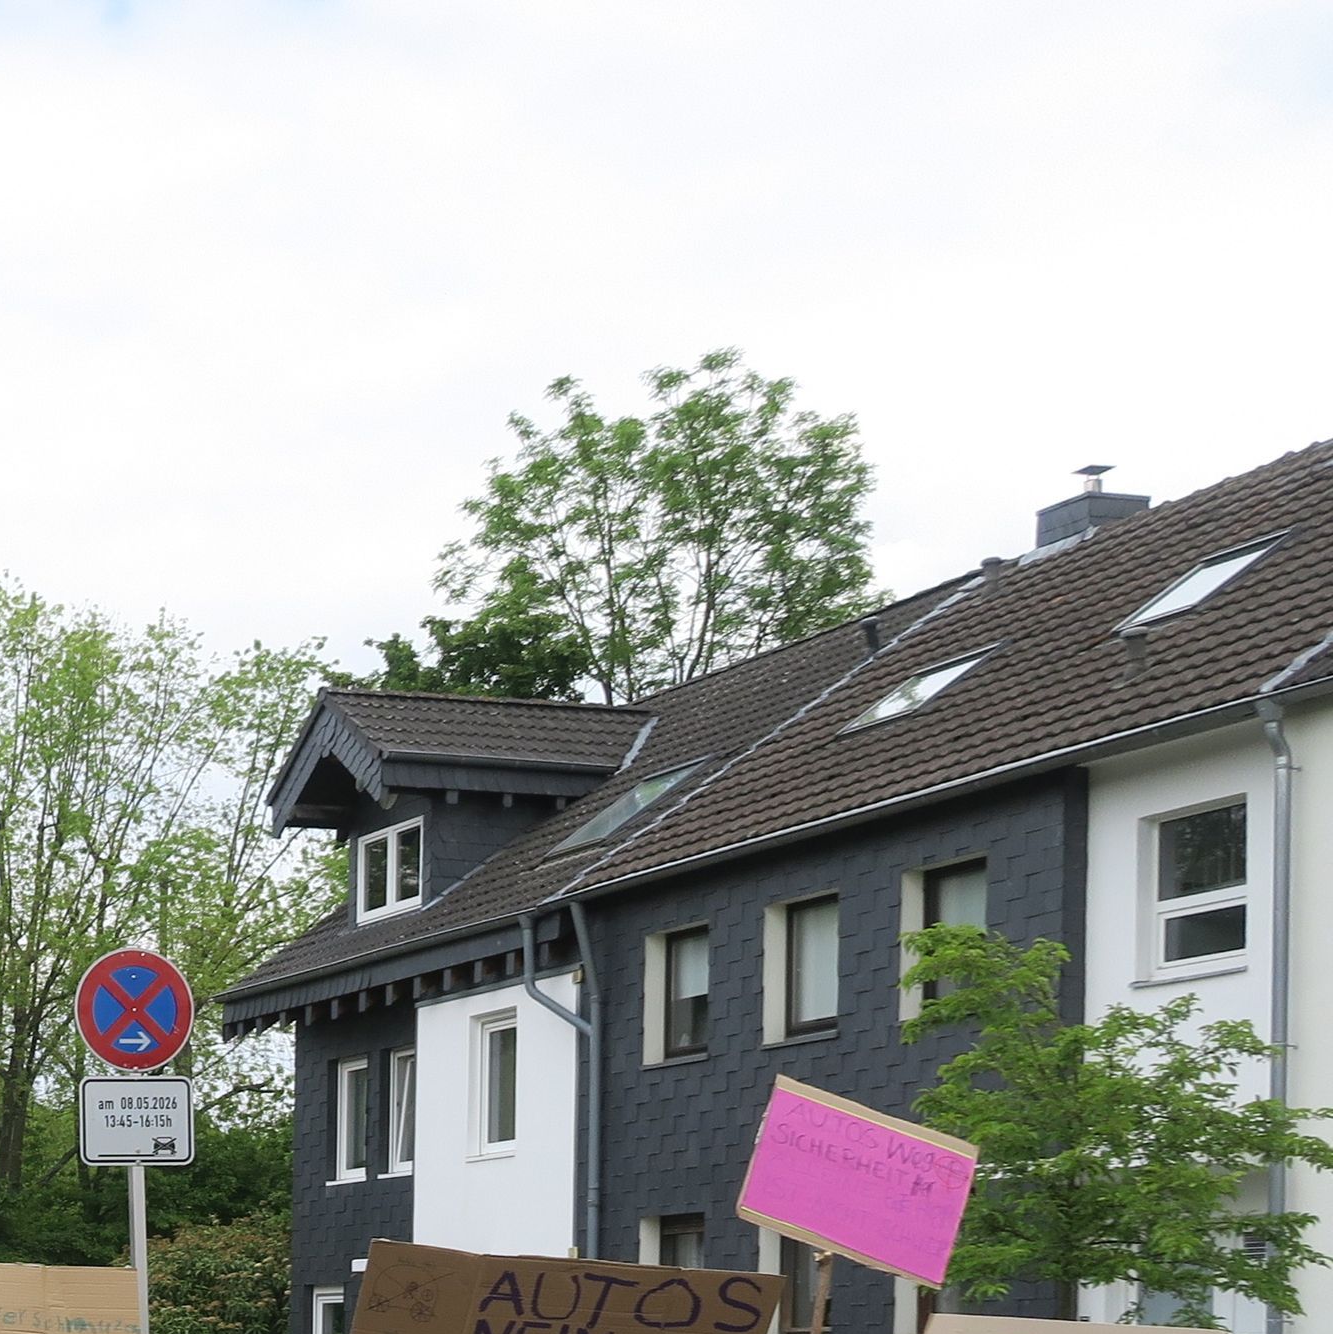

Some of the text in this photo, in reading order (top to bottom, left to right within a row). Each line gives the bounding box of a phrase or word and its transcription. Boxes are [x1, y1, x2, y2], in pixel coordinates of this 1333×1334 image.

[98, 1097, 178, 1110] am 08.05.2026
[104, 1115, 172, 1128] 13:45-16:15h
[784, 1103, 879, 1149] AUTOS
[769, 1122, 911, 1185] SICHERHEIT
[478, 1270, 763, 1333] AUTOS
